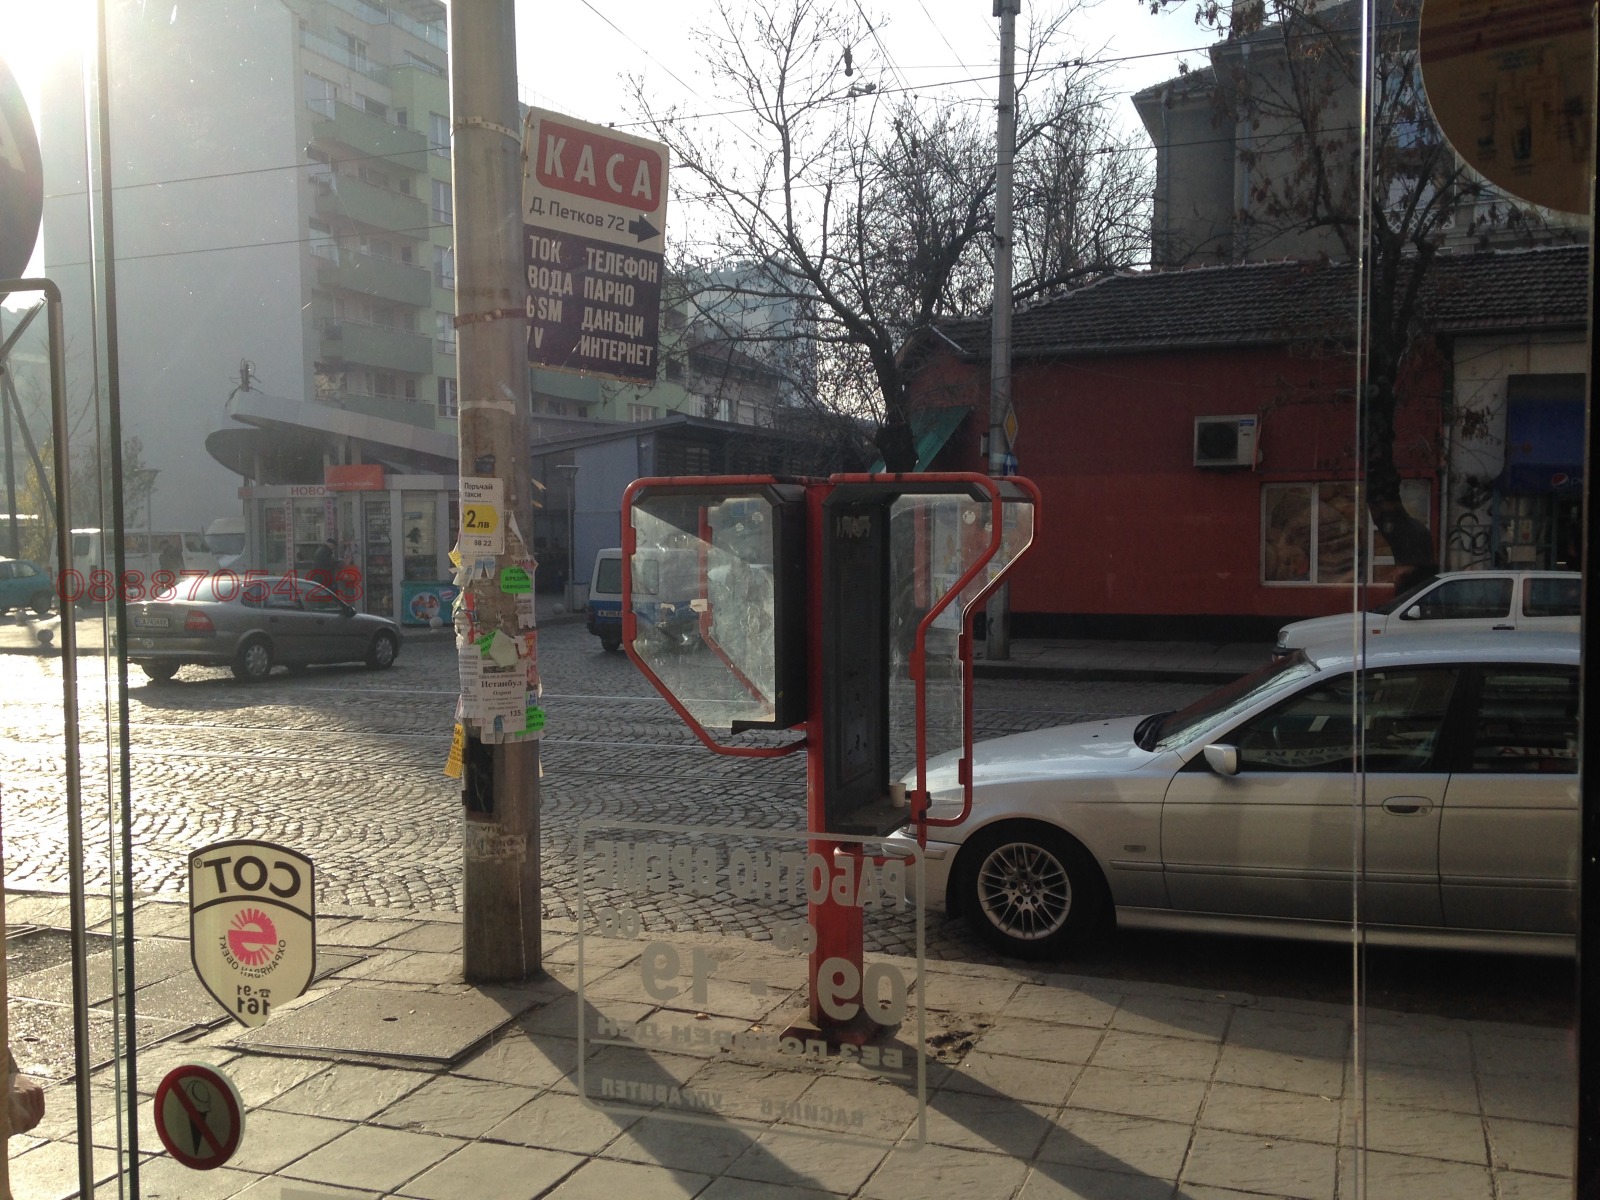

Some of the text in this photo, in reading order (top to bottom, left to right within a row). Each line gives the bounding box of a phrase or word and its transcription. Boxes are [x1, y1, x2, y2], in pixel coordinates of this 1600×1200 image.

[544, 134, 653, 200] КАСА
[529, 196, 625, 232] Д. Петков 72
[529, 235, 562, 264] ТОК
[585, 247, 658, 283] ТЕЛЕФОН
[527, 264, 574, 297] ВОДА
[583, 276, 635, 307] ПАРНО
[581, 306, 644, 339] ДАНЪЦИ
[580, 335, 653, 366] ИНТЕРНЕТ
[291, 487, 325, 496] НОВО
[464, 482, 493, 490] Поръчай
[466, 509, 490, 529] 2 лв
[56, 569, 364, 602] 0888705423
